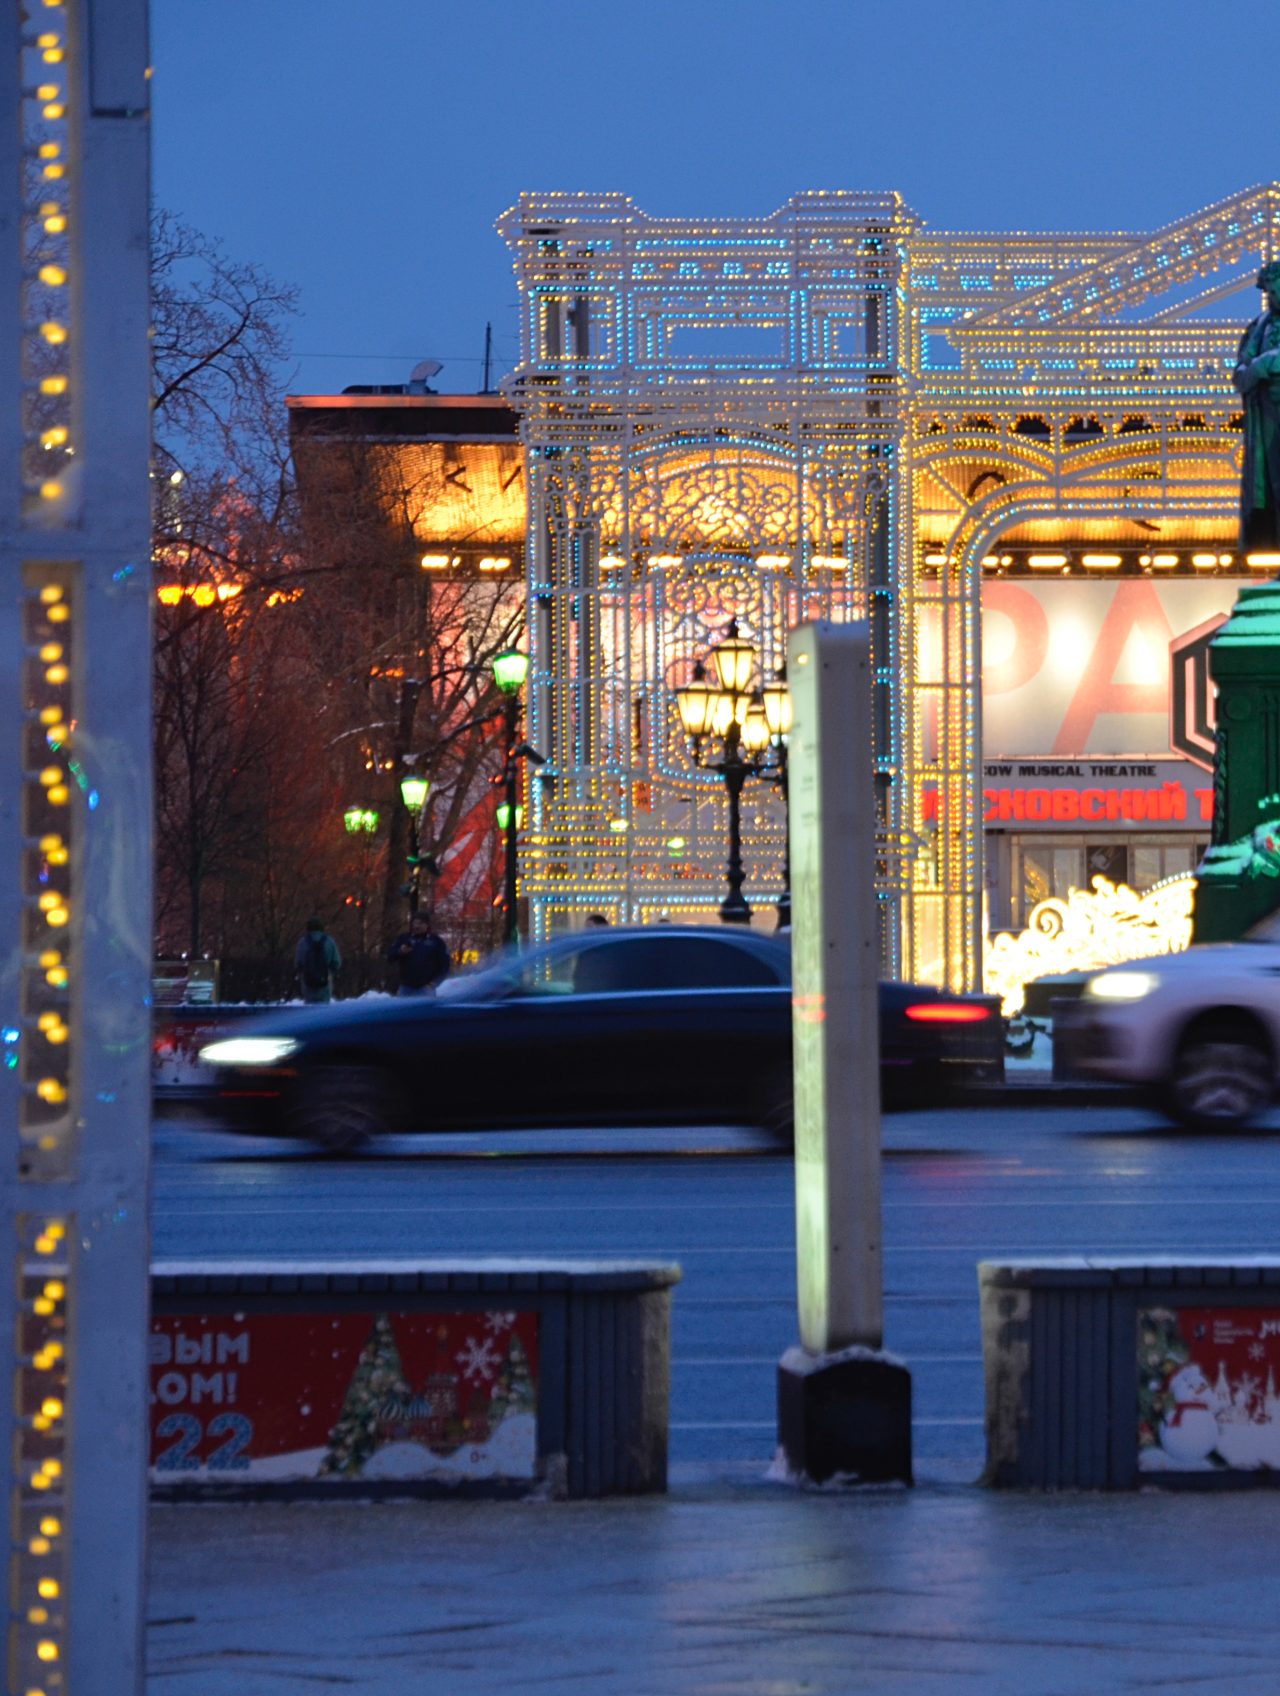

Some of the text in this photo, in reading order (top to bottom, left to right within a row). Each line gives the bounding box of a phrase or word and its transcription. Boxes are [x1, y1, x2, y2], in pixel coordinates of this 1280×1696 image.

[1018, 765, 1084, 777] MUSICAL
[1089, 765, 1157, 777] THEATRE
[151, 1331, 250, 1365] ВЫМ
[151, 1371, 239, 1405] ОМ!
[156, 1412, 254, 1471] 22
